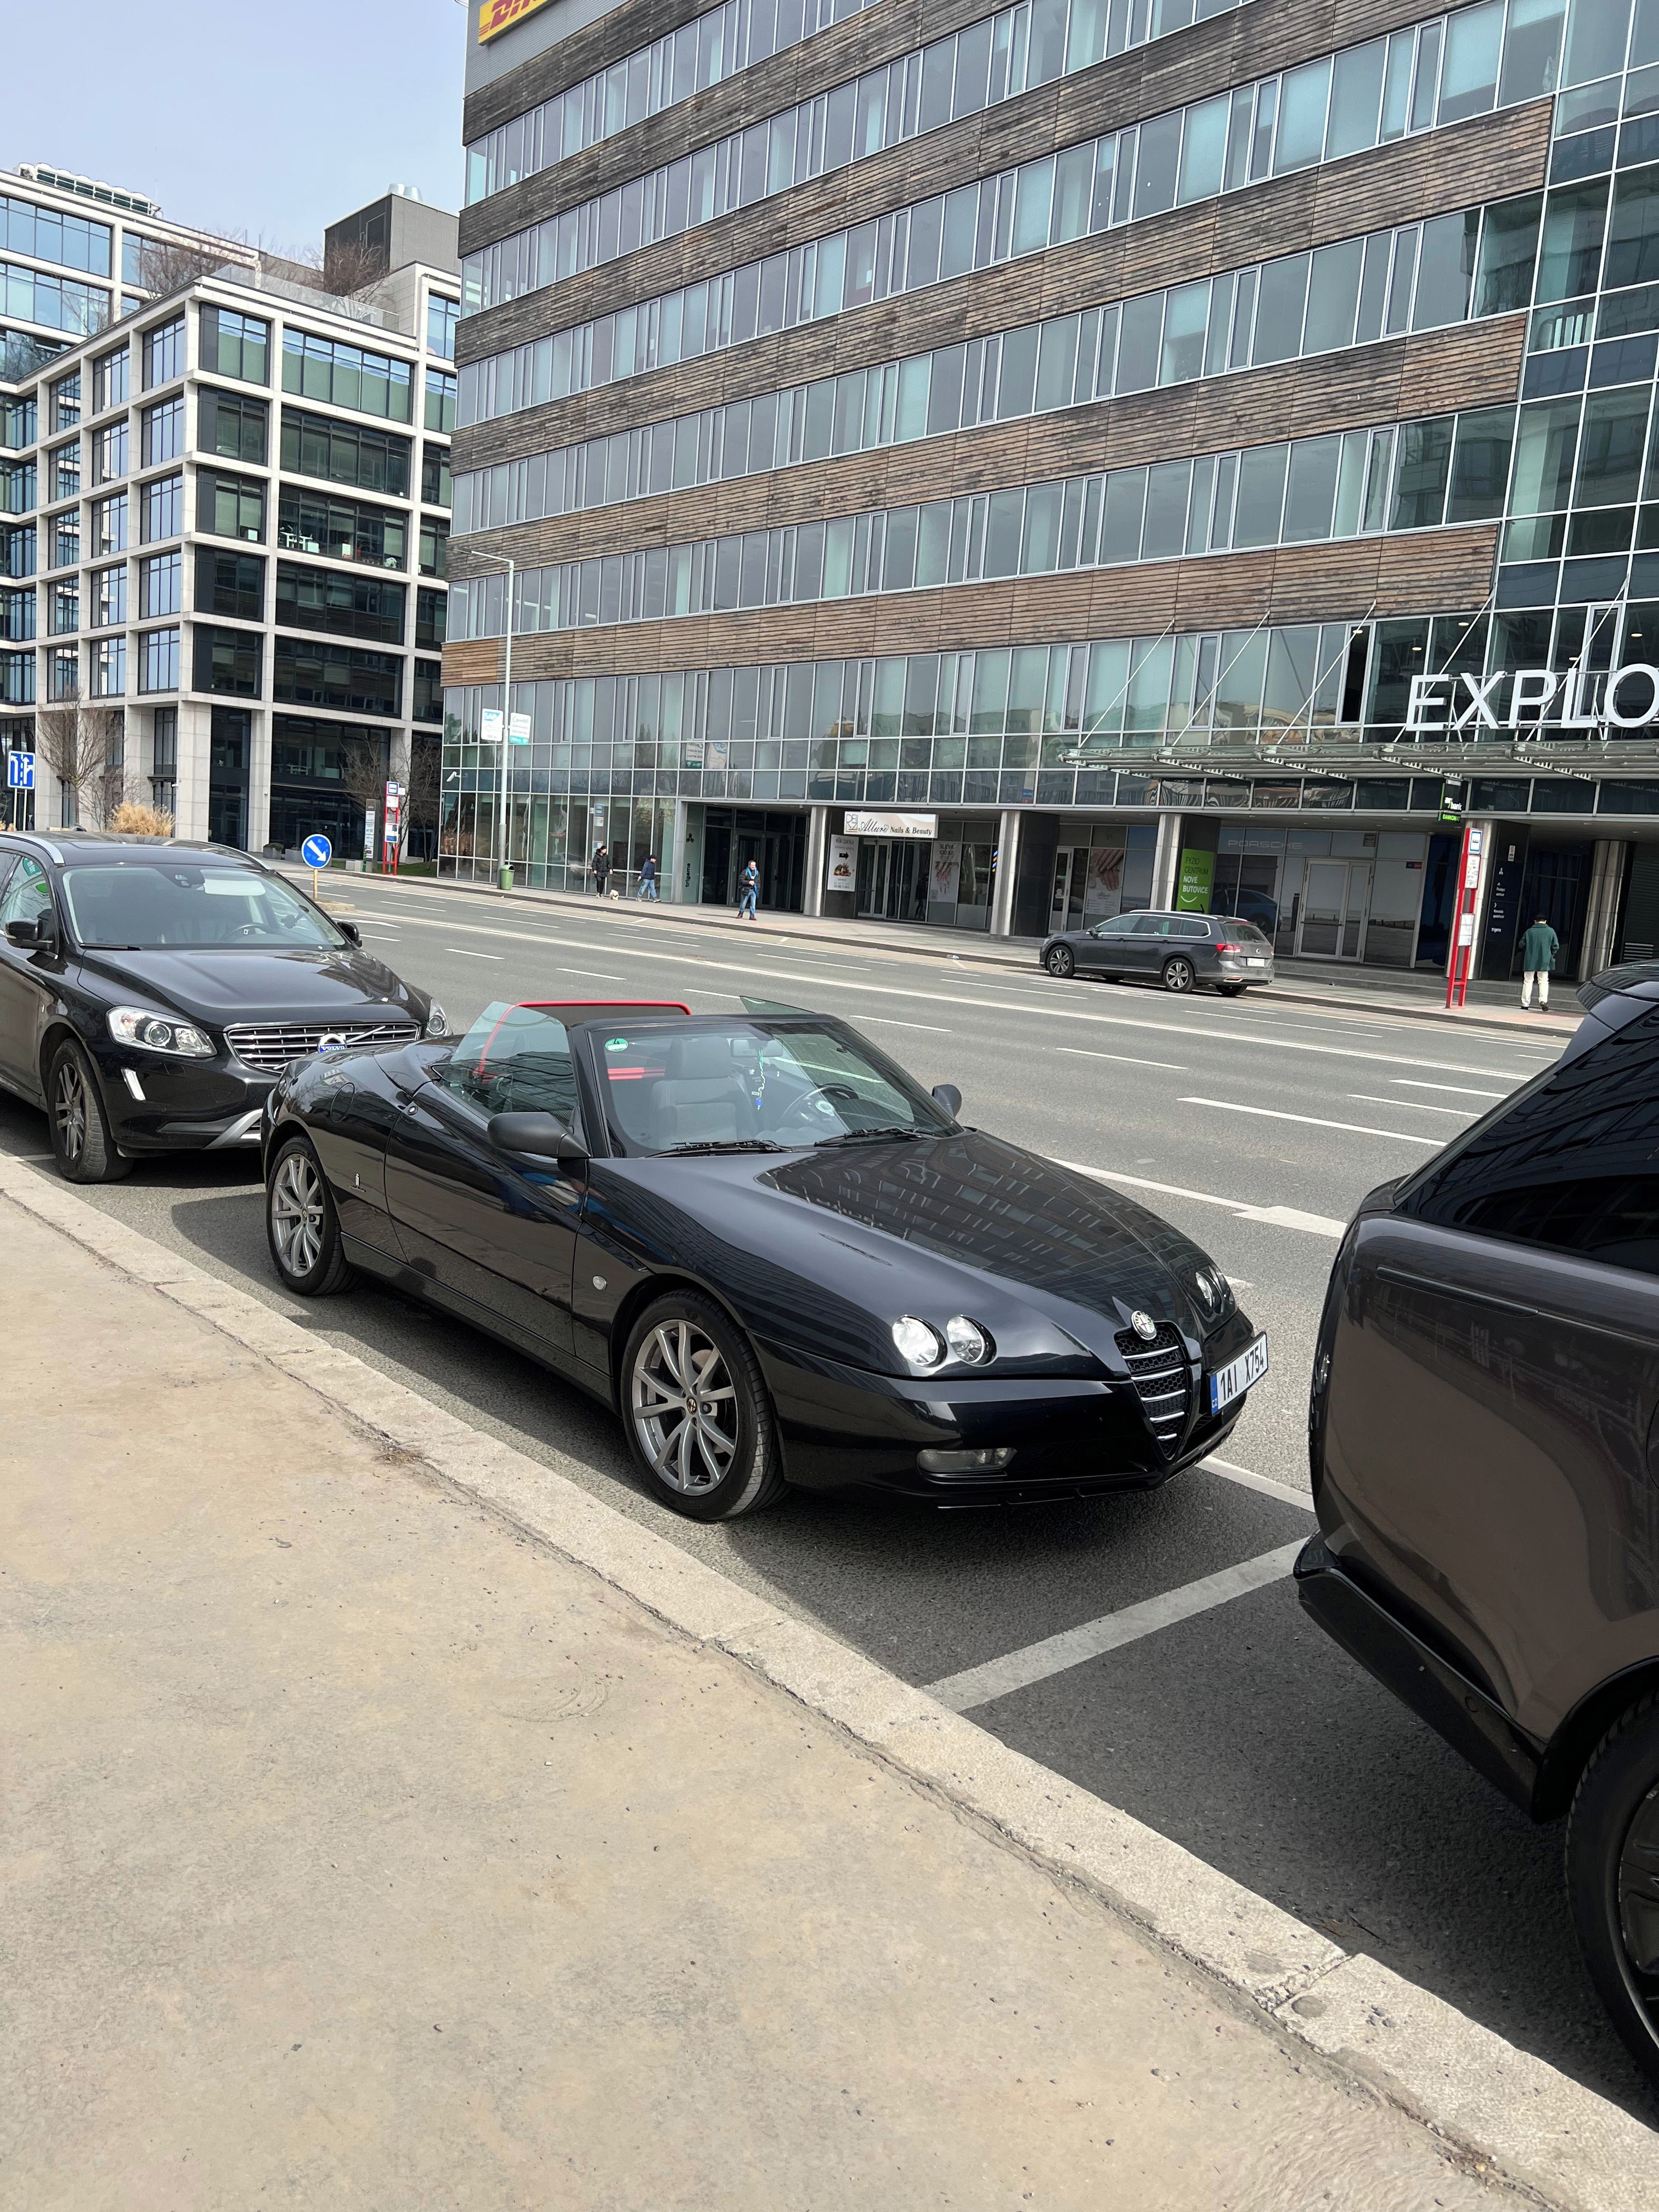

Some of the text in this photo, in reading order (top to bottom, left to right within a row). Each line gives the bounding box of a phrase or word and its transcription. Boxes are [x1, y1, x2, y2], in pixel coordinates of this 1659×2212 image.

[1406, 663, 1659, 732] EXPLO
[912, 827, 932, 836] Beauty
[1228, 840, 1303, 849] PORSCHE
[1184, 866, 1208, 874] CENTRUM
[1183, 875, 1198, 883] NOVÉ
[1182, 885, 1208, 894] BUTOVICE
[1245, 1342, 1264, 1384] X754
